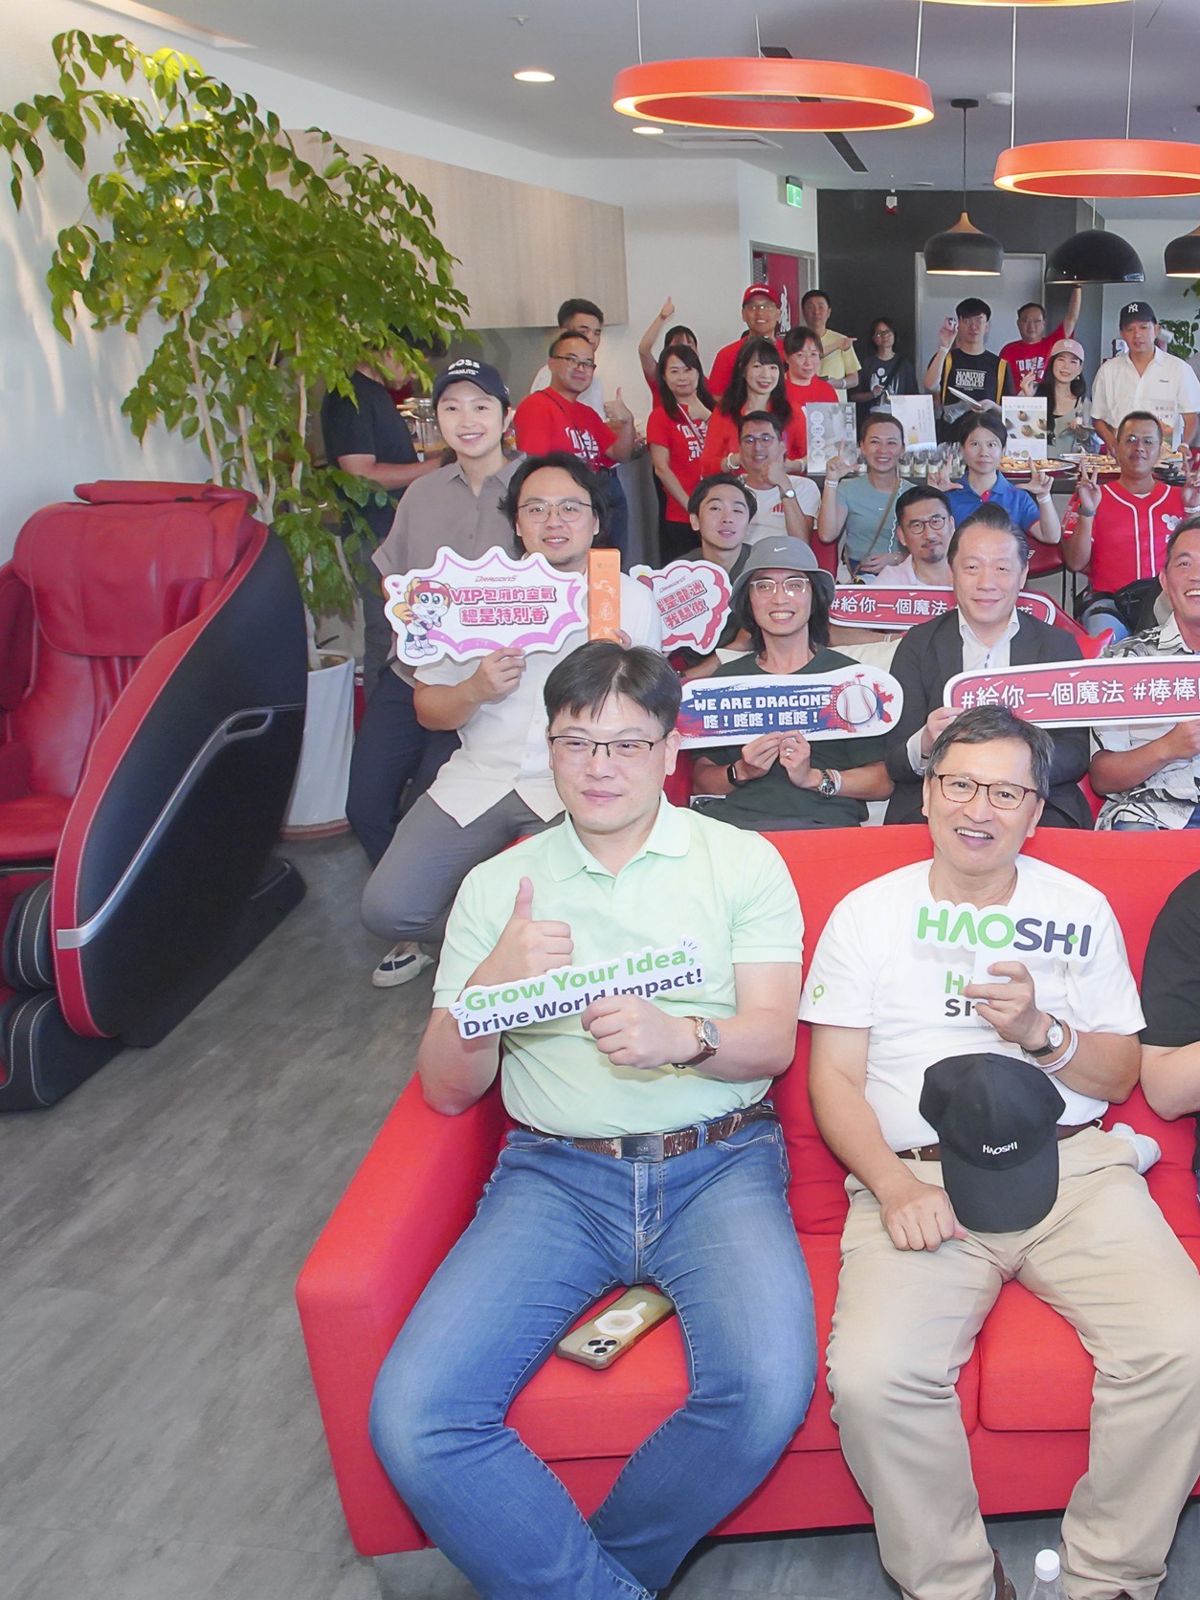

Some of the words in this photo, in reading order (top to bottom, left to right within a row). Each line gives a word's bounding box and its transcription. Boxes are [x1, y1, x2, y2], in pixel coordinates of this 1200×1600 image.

[451, 587, 556, 605] VIP包廂的空氣
[830, 594, 948, 617] #給你一個魔法
[461, 606, 549, 624] 總是特別香
[694, 698, 717, 711] WE
[720, 696, 752, 710] ARE
[755, 694, 831, 708] DRAGONS
[961, 680, 1125, 708] #給你一個魔法
[916, 906, 1092, 957] HAOSHI
[464, 980, 546, 1012] Grow
[551, 965, 619, 992] Your
[626, 949, 696, 976] Idea,
[463, 1010, 530, 1036] Drive
[533, 990, 607, 1019] World
[982, 1141, 1018, 1155] HAOSHI
